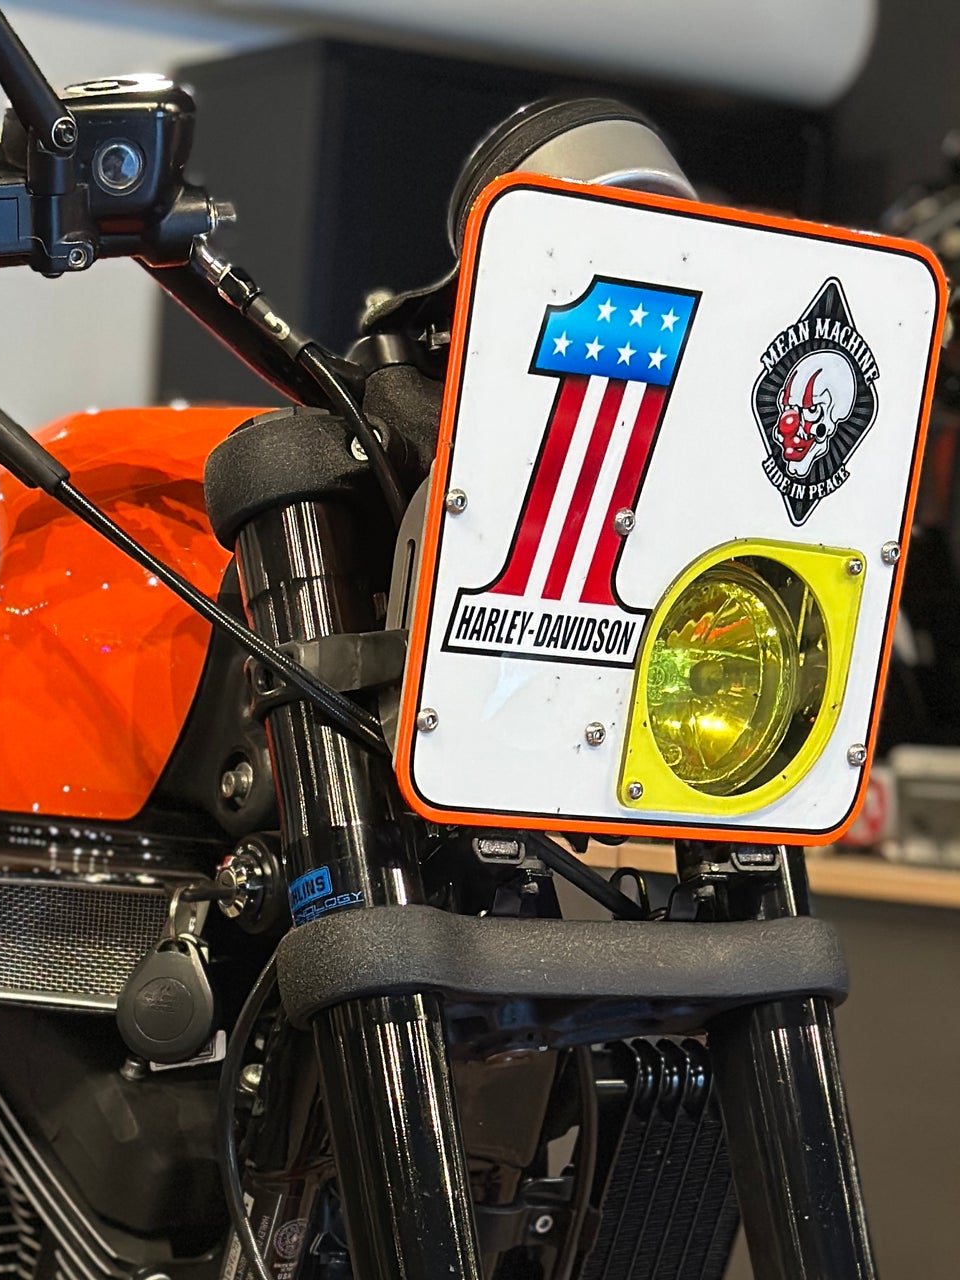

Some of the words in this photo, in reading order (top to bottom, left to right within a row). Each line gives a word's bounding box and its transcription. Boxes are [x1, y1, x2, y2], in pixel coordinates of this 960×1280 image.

[761, 319, 810, 373] MEAN
[814, 317, 879, 386] MACHINE
[440, 274, 703, 668] 1
[763, 456, 790, 493] RIDE
[790, 482, 806, 500] IN
[808, 464, 849, 500] PEACE
[455, 604, 637, 656] HARLEY-DAVIDSON
[292, 876, 325, 904] HLINS
